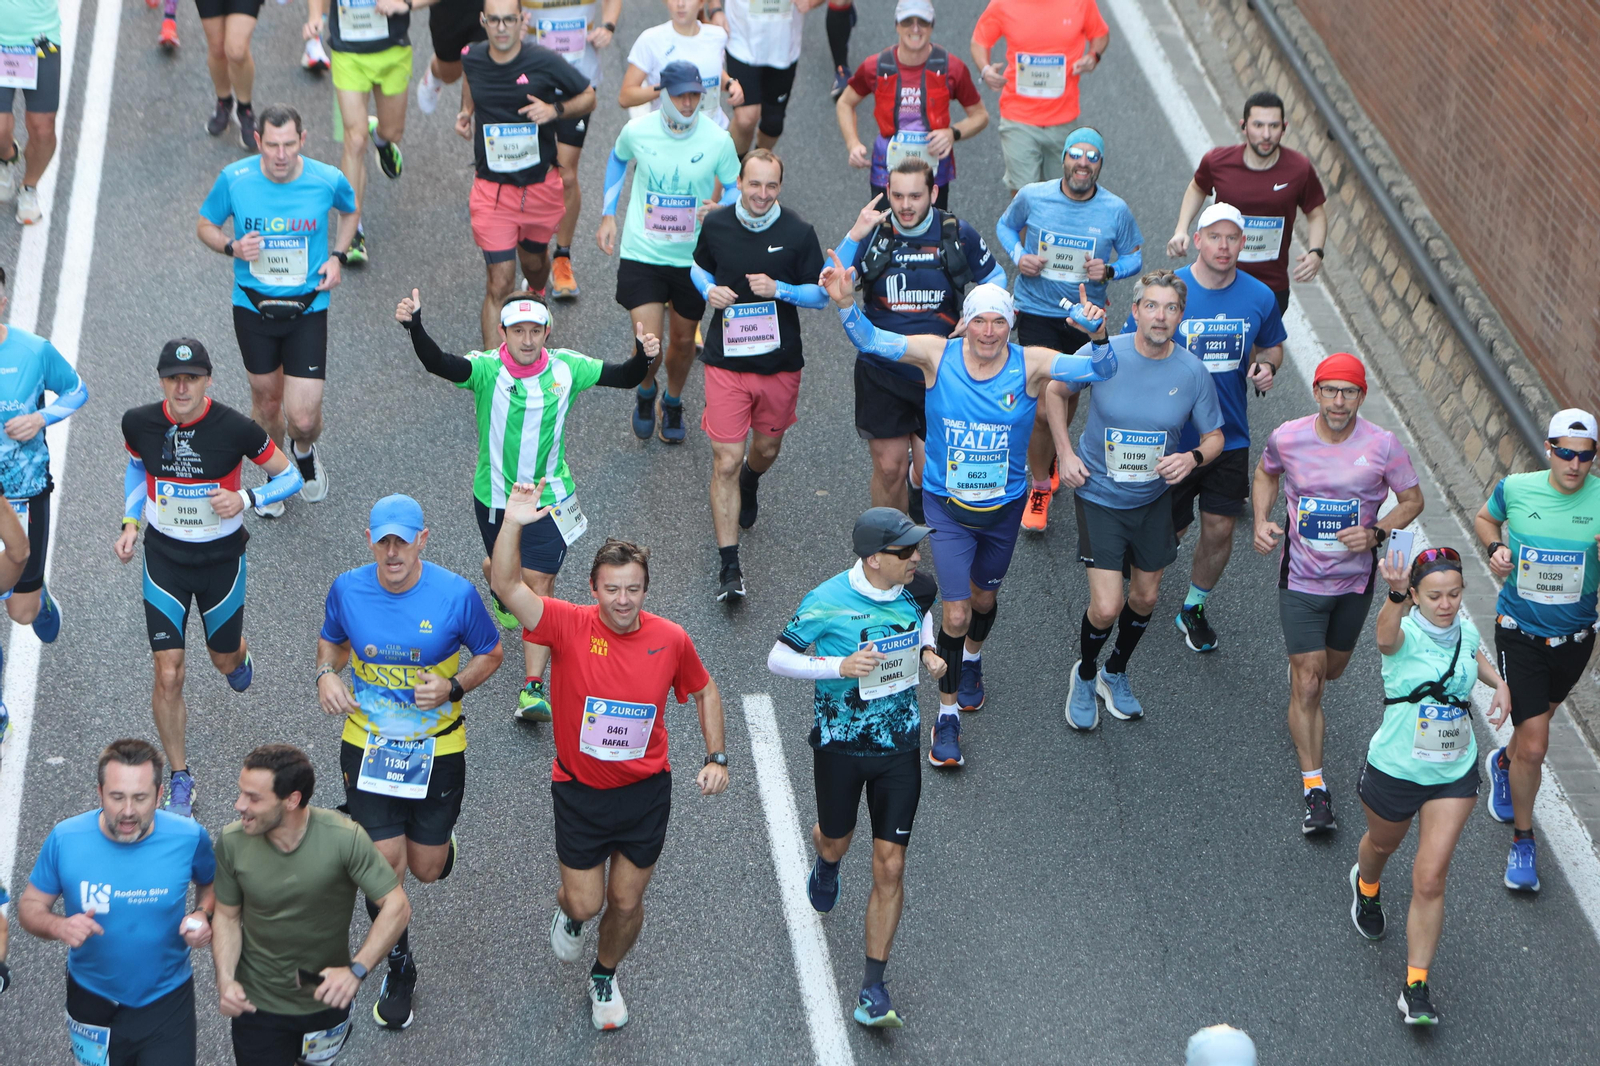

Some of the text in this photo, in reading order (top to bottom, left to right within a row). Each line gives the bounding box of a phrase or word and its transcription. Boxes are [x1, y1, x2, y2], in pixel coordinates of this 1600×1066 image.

[1033, 56, 1060, 64] ZURICH
[901, 87, 922, 97] EDIA
[901, 97, 922, 106] ARA
[503, 126, 532, 136] ZURICH
[662, 198, 691, 207] ZURICH
[661, 214, 678, 222] 6996
[244, 217, 317, 232] BELGIUM
[652, 223, 687, 232] JUAN PABLO
[1247, 219, 1277, 228] ZURICH
[268, 239, 300, 248] ZURICH
[1058, 238, 1089, 249] ZURICH
[267, 256, 289, 265] 10011
[903, 253, 935, 262] FAUN
[1055, 253, 1074, 262] 9979
[1052, 262, 1075, 271] NANDO
[738, 306, 769, 316] ZURICH
[740, 324, 758, 333] 7606
[1207, 323, 1238, 332] ZURICH
[727, 334, 775, 344] DAVIDFROMBCN
[1205, 341, 1227, 351] 12211
[1203, 352, 1230, 361] ANDREW
[942, 417, 1013, 432] TRAVEL MARATHON
[945, 427, 1010, 450] ITALIA
[1126, 434, 1159, 445] ZURICH
[968, 453, 1002, 463] ZURICH
[1122, 452, 1147, 461] 10199
[161, 464, 204, 475] MARATON
[1118, 463, 1149, 472] JACQUES
[967, 471, 988, 480] 6623
[956, 481, 998, 490] SEBASTIANO
[177, 487, 213, 498] ZURICH
[177, 506, 198, 515] 9189
[1319, 504, 1353, 513] ZURICH
[173, 517, 204, 526] S PARRA
[1317, 520, 1342, 530] 11315
[1541, 553, 1577, 563] ZURICH
[1538, 571, 1564, 581] 10329
[1536, 582, 1564, 592] COLIBRÍ
[851, 613, 871, 622] FASTER
[590, 635, 608, 648] SPAÑA
[881, 635, 915, 652] ZURICH
[378, 649, 410, 658] ATLETISMO
[879, 658, 904, 672] 10507
[880, 671, 905, 683] ISMAEL
[610, 705, 649, 718] ZURICH
[606, 725, 629, 736] 8461
[390, 739, 425, 751] ZURICH
[601, 738, 631, 748] RAFAEL
[384, 757, 411, 771] 11301
[386, 771, 405, 783] BOIX
[113, 887, 170, 899] Rodolfo Silva
[126, 896, 159, 905] Seguros
